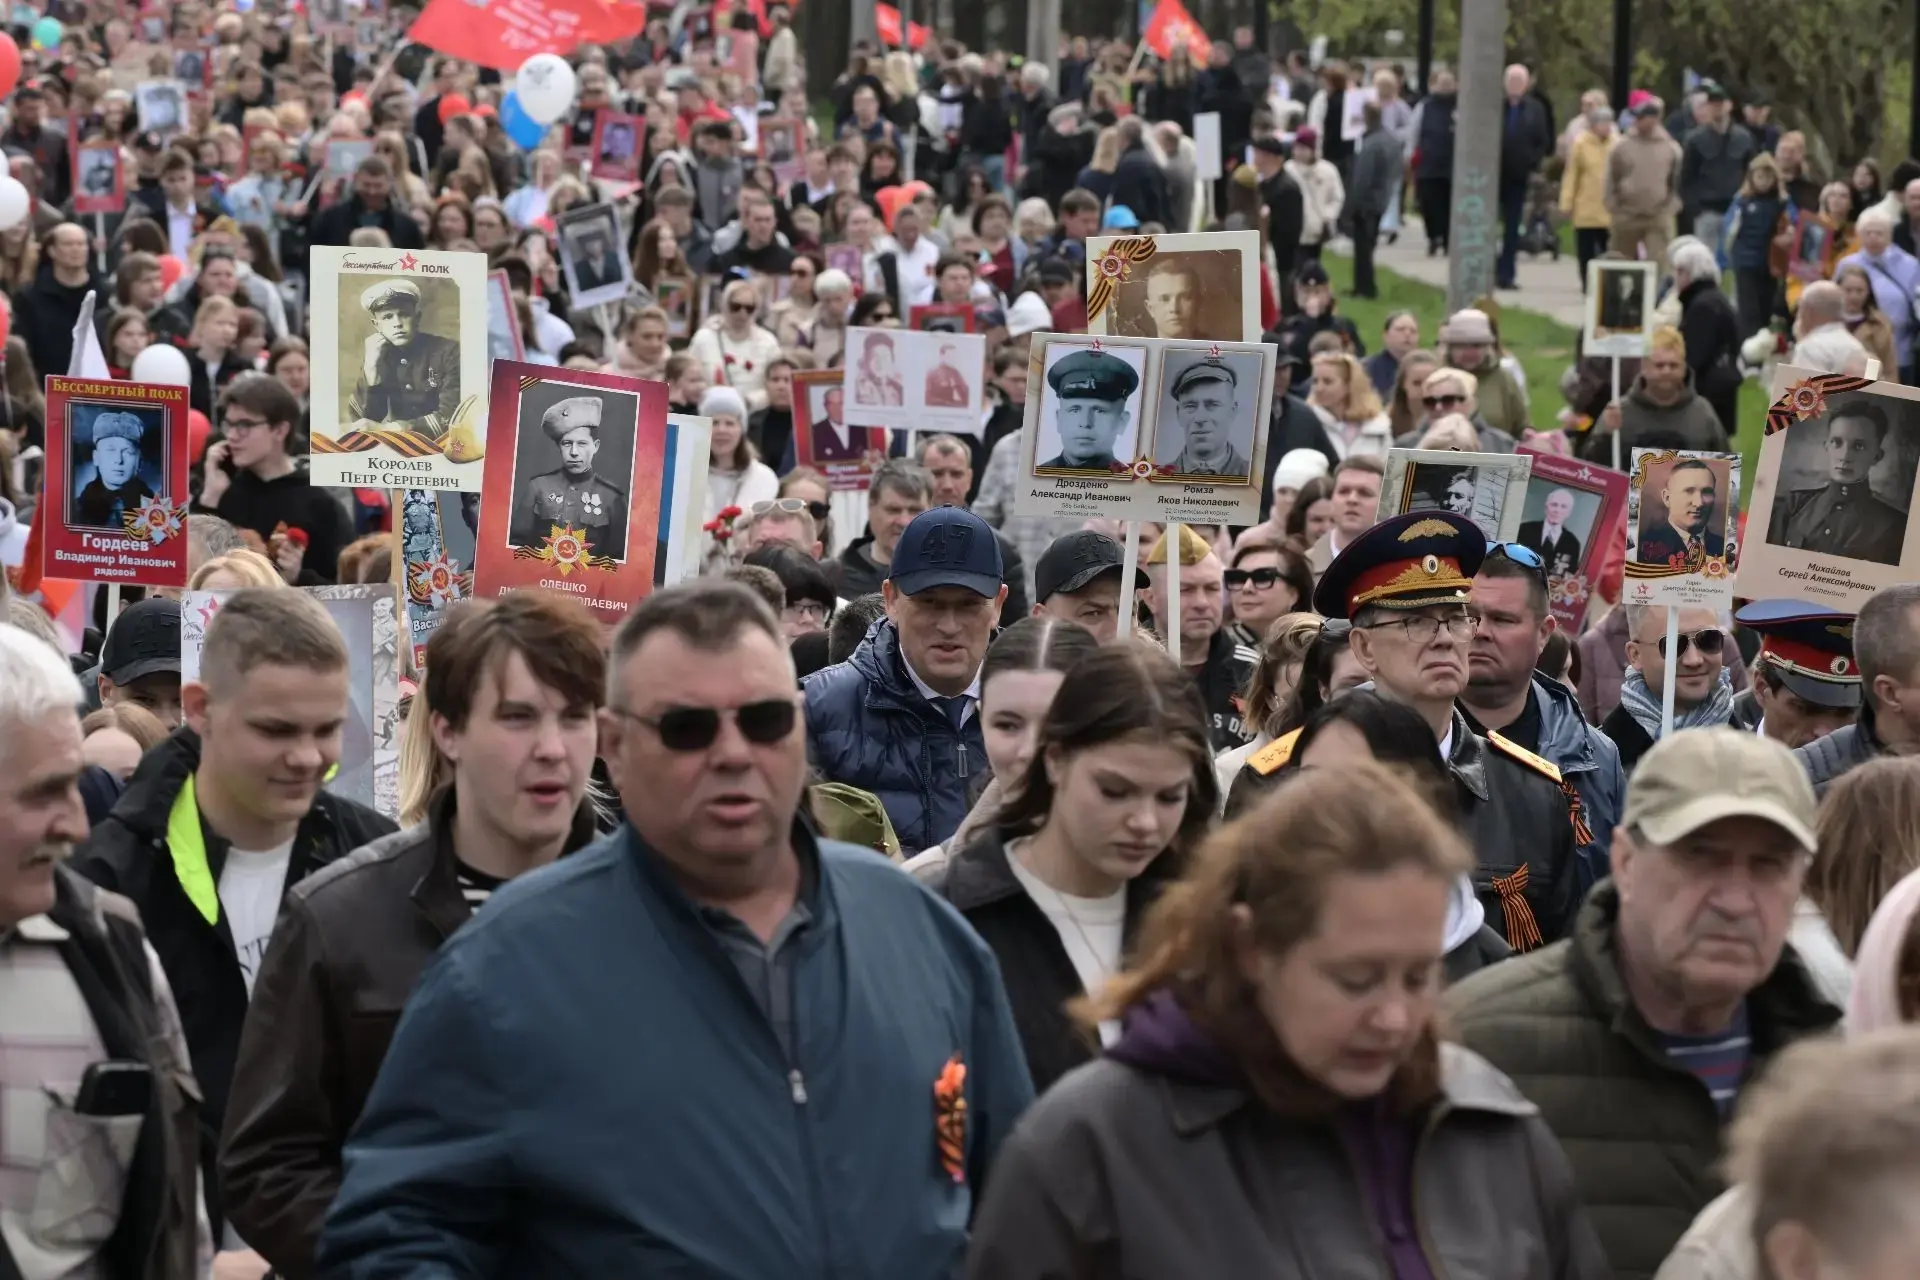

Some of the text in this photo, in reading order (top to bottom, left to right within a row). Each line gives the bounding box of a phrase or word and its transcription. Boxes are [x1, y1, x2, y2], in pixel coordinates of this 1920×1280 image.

[1055, 478, 1109, 490] Дрозденко
[1183, 484, 1214, 494] Ромза
[1030, 489, 1131, 502] Александр Иванович
[1157, 495, 1239, 507] Яков Николаевич
[82, 533, 149, 552] Гордеев
[917, 523, 974, 564] 47
[55, 549, 176, 568] Владимир Иванович
[94, 566, 136, 577] рядовой
[1807, 562, 1851, 577] Михайлов
[540, 578, 587, 593] ОЛЕШКО
[1778, 567, 1876, 592] Сергей Александрович
